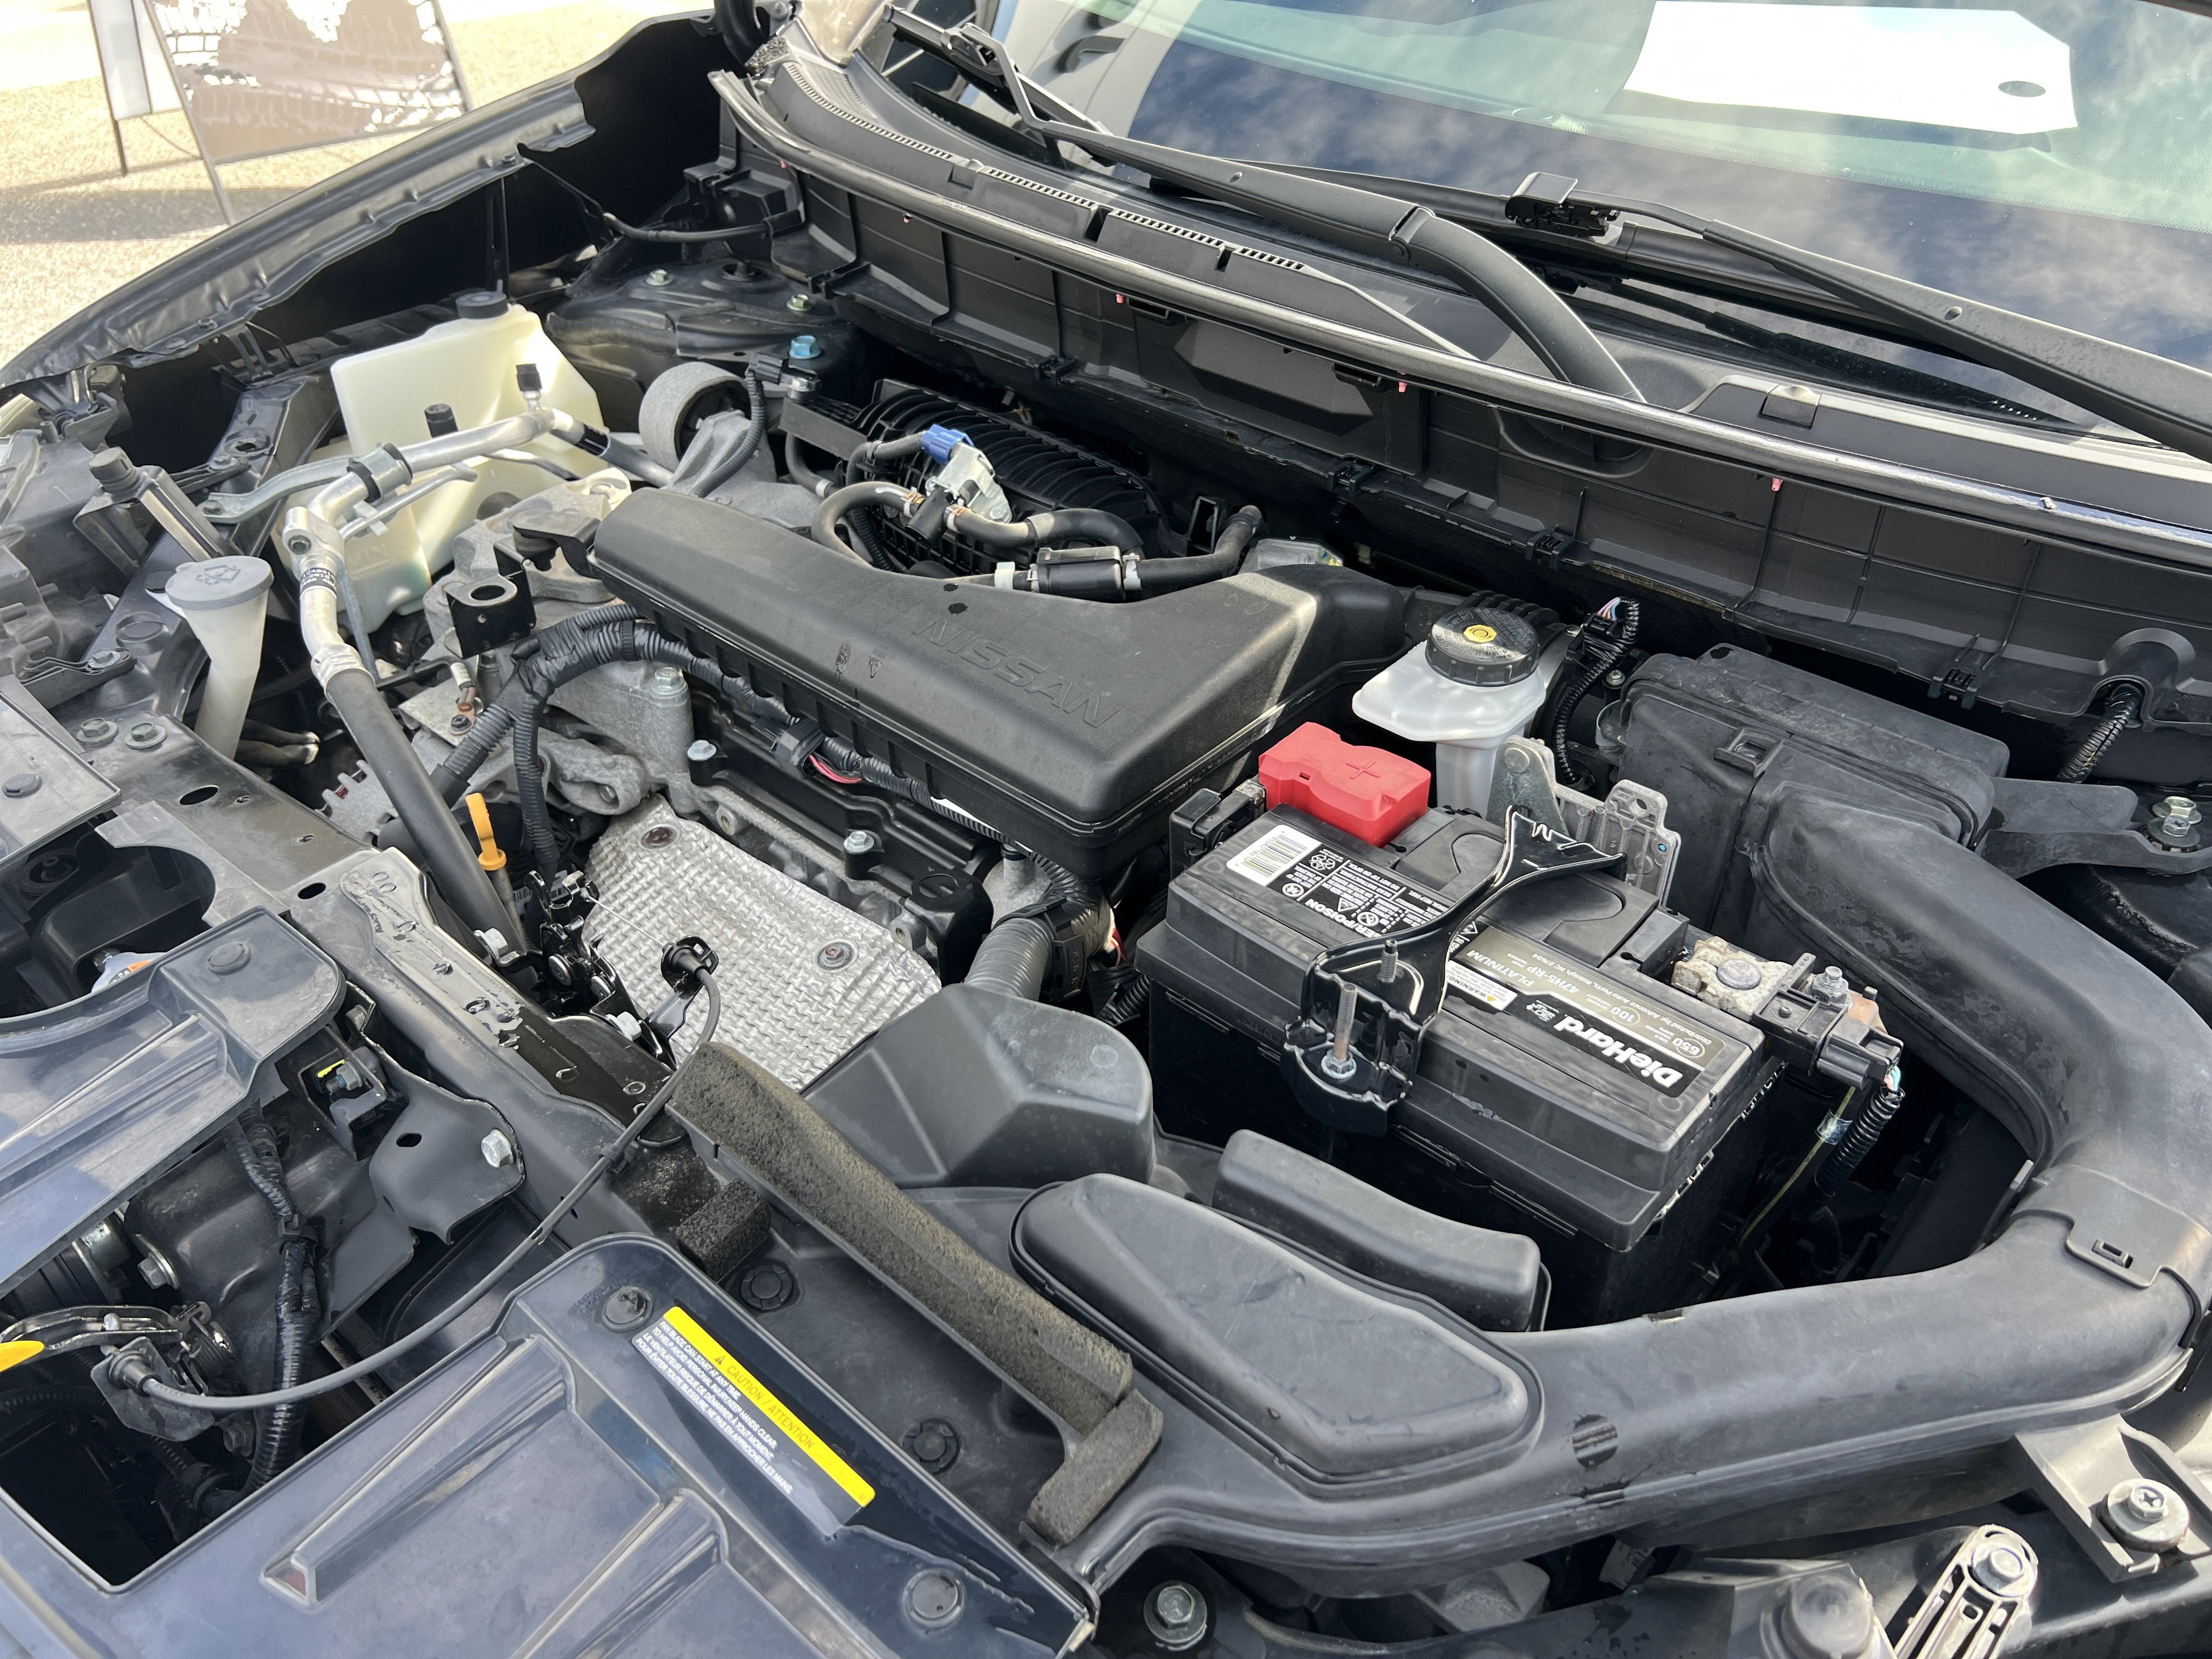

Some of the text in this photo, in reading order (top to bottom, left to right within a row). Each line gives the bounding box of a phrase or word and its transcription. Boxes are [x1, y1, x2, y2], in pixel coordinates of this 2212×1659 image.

[911, 618, 1121, 729] NISSAN
[1338, 868, 1379, 890] INSTRUCTIONS.
[1378, 877, 1393, 887] NOT
[1303, 898, 1381, 938] ER/POISON
[1466, 949, 1536, 986] PLATINUM
[1531, 951, 1713, 1045] Distributed by: Advance Auto Parts, Raleigh, NC 27604
[1609, 1005, 1635, 1023] 100
[1671, 1036, 1701, 1055] 650
[641, 1332, 653, 1342] LE
[648, 1338, 683, 1371] VENTILATEUR
[658, 1320, 673, 1333] FAN
[667, 1329, 687, 1347] BLADE
[682, 1344, 698, 1358] CAN
[693, 1354, 713, 1372] START
[708, 1368, 719, 1378] AT
[714, 1374, 730, 1389] ANY
[650, 1326, 663, 1336] TO
[657, 1333, 675, 1348] HELP
[669, 1345, 690, 1362] AVOID
[684, 1358, 714, 1386] PERSONAL
[725, 1398, 744, 1415] KEEP
[737, 1409, 761, 1432] HANDS
[755, 1427, 777, 1449] CLEAR.
[677, 1367, 701, 1389] RISQUE
[695, 1384, 709, 1396] DE
[634, 1337, 654, 1356] POUR
[648, 1350, 672, 1371] ÉVITER
[664, 1367, 685, 1386] TOUTE
[705, 1407, 718, 1418] NE
[713, 1414, 729, 1429] PAS
[723, 1424, 736, 1436] EN
[730, 1431, 767, 1466] APPROCHER
[761, 1462, 777, 1476] LES
[703, 1390, 736, 1421] DÉMARRER
[725, 1363, 816, 1450] CAUTION / ATTENTION
[729, 1415, 741, 1425] À
[733, 1420, 753, 1439] TOUT
